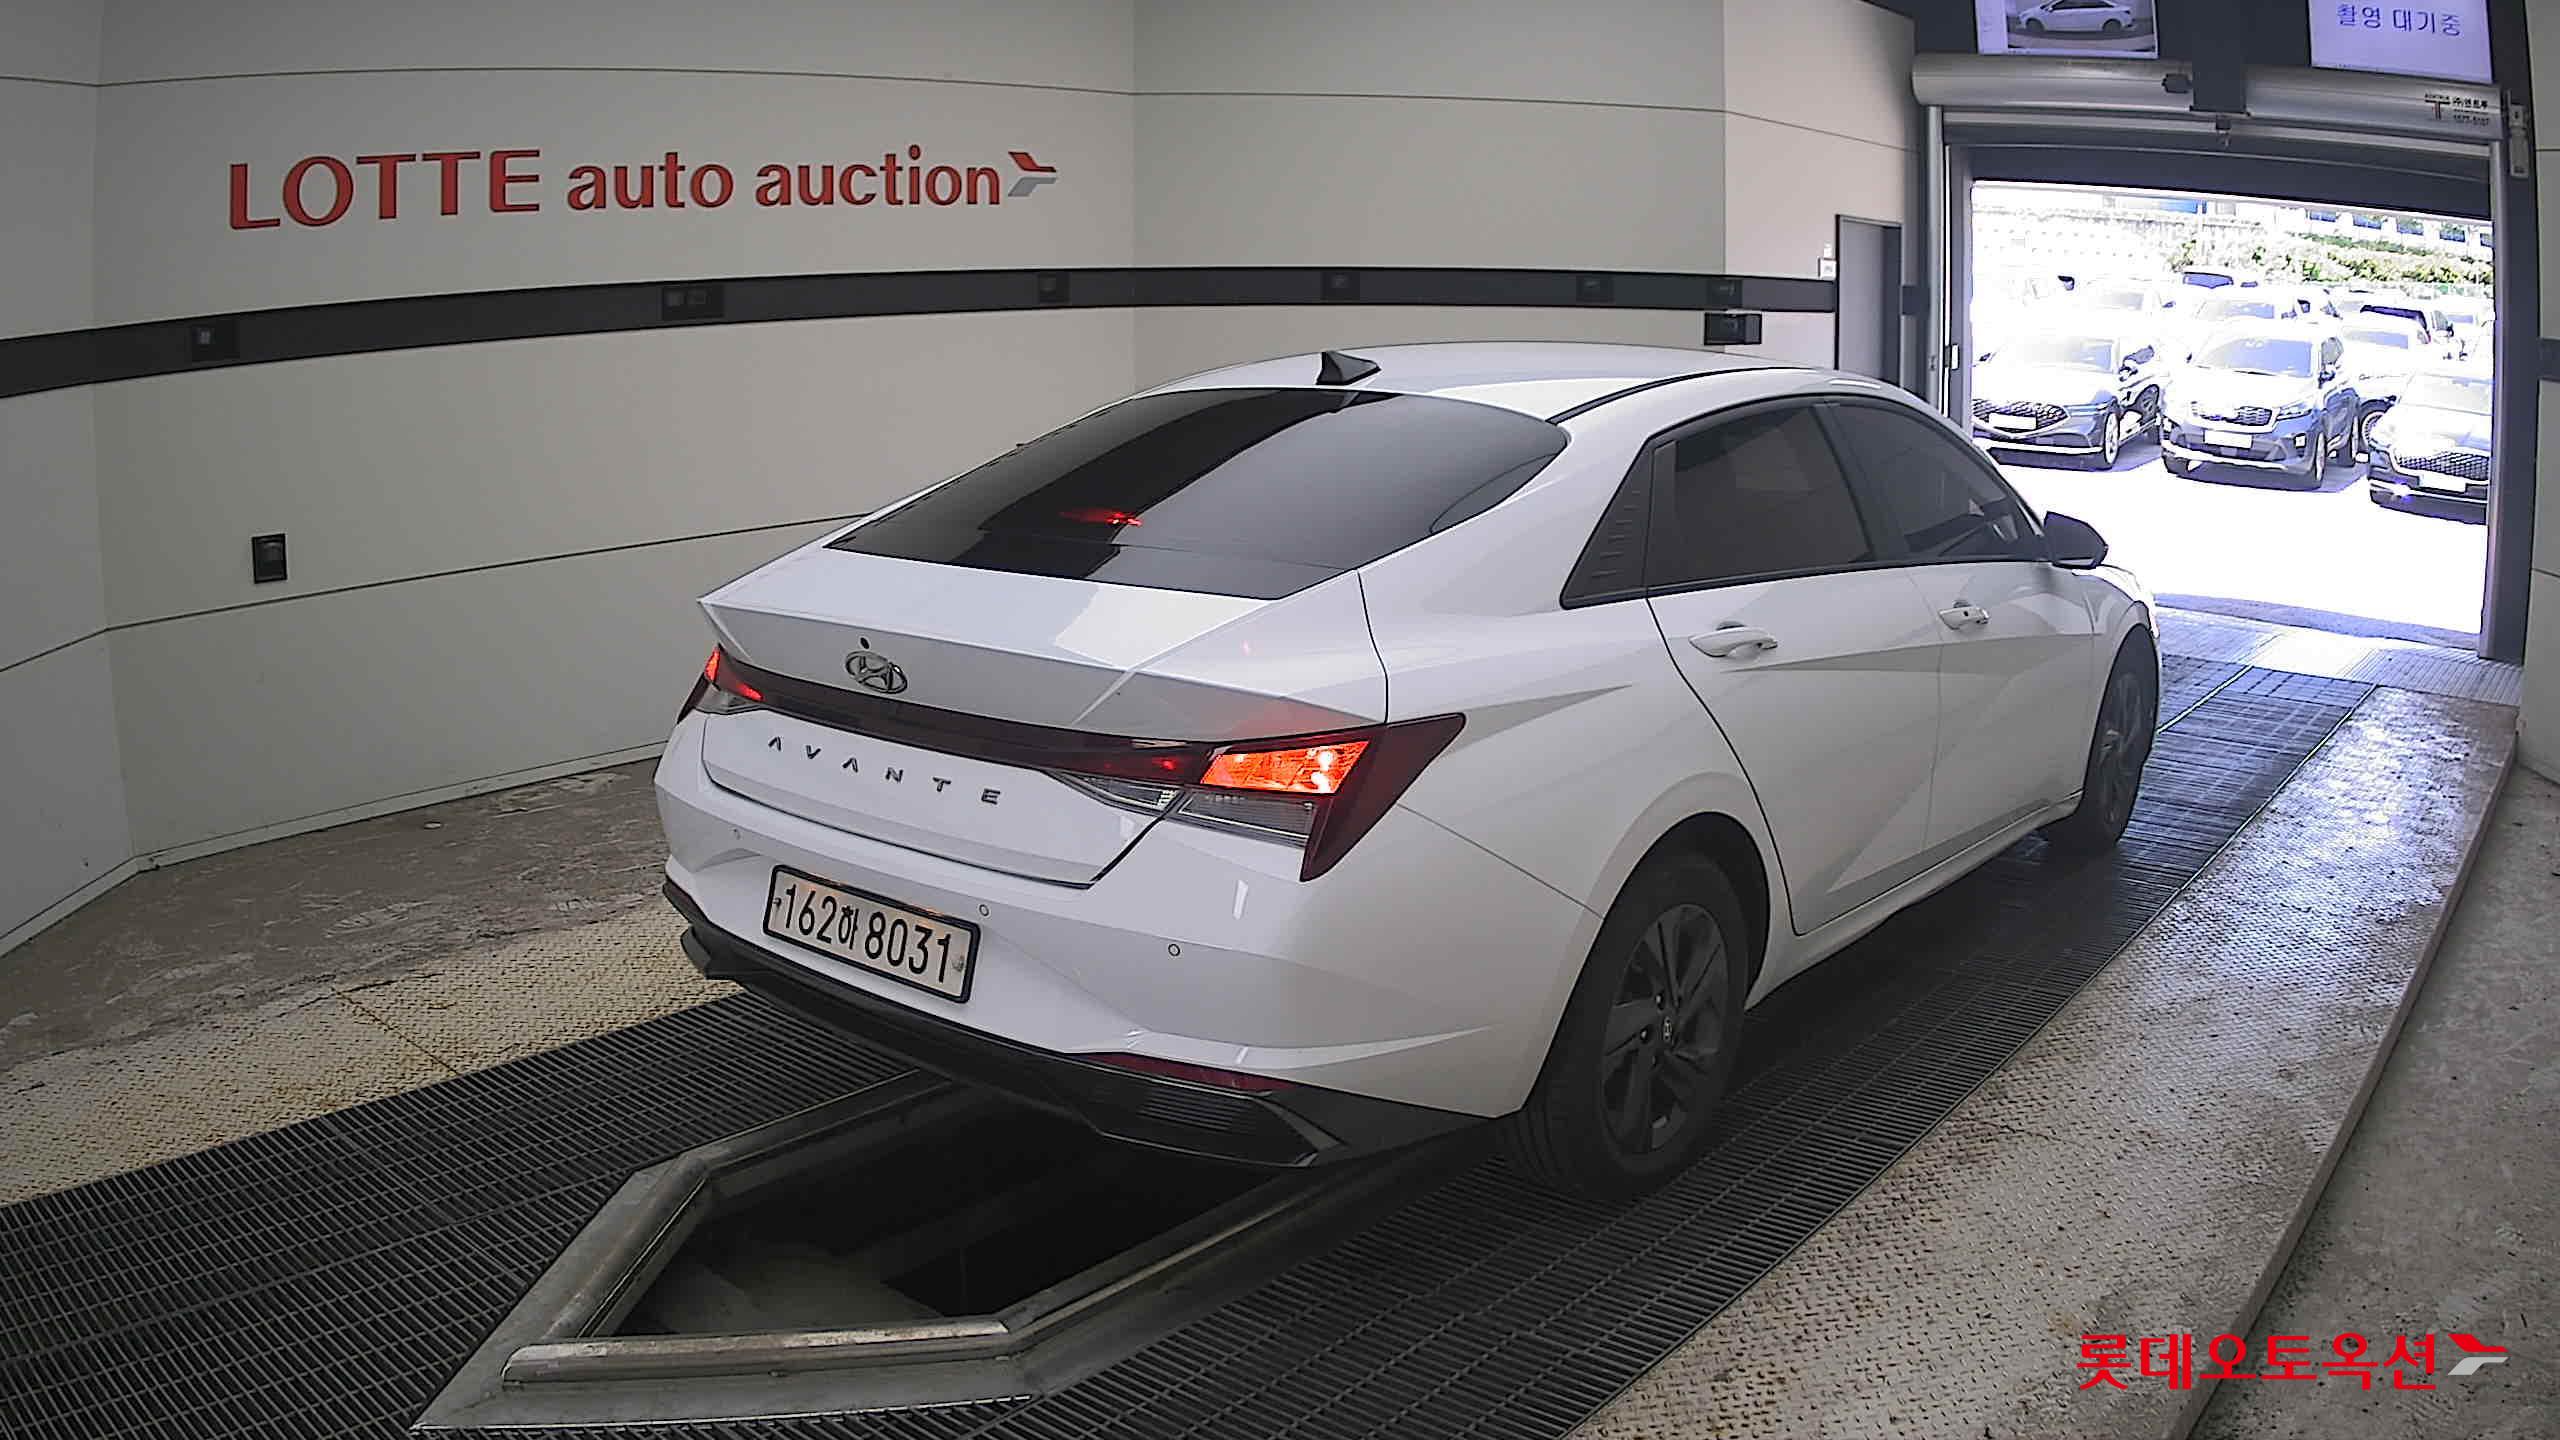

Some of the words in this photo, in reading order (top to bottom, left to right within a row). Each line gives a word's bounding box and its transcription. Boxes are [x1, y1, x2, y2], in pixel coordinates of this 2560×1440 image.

[2337, 4, 2381, 29] 촬영
[2392, 9, 2461, 36] 대기중
[230, 150, 541, 230] LOTTE
[567, 151, 735, 210] auto
[755, 145, 1001, 206] auction
[768, 735, 1001, 804] AVANTE
